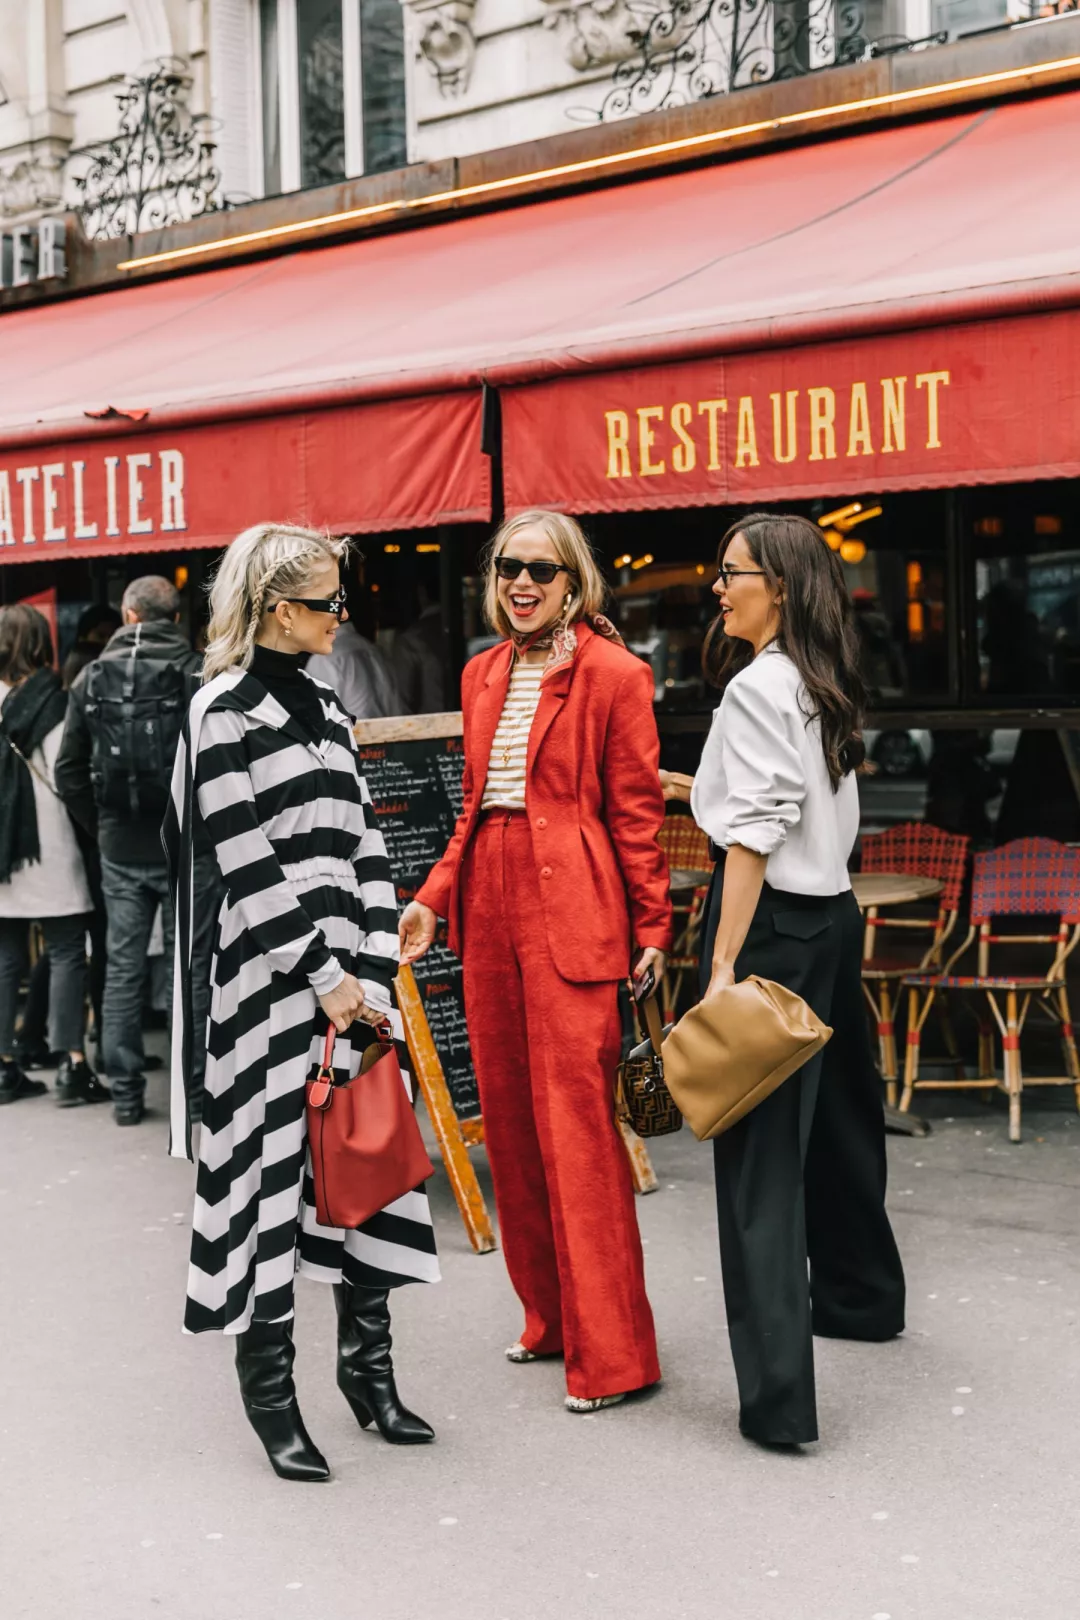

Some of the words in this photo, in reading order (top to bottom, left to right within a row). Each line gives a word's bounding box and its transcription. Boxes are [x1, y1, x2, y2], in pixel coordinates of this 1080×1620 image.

[0, 216, 66, 291] ER
[604, 371, 951, 479] RESTAURANT
[0, 449, 187, 546] ATELIER
